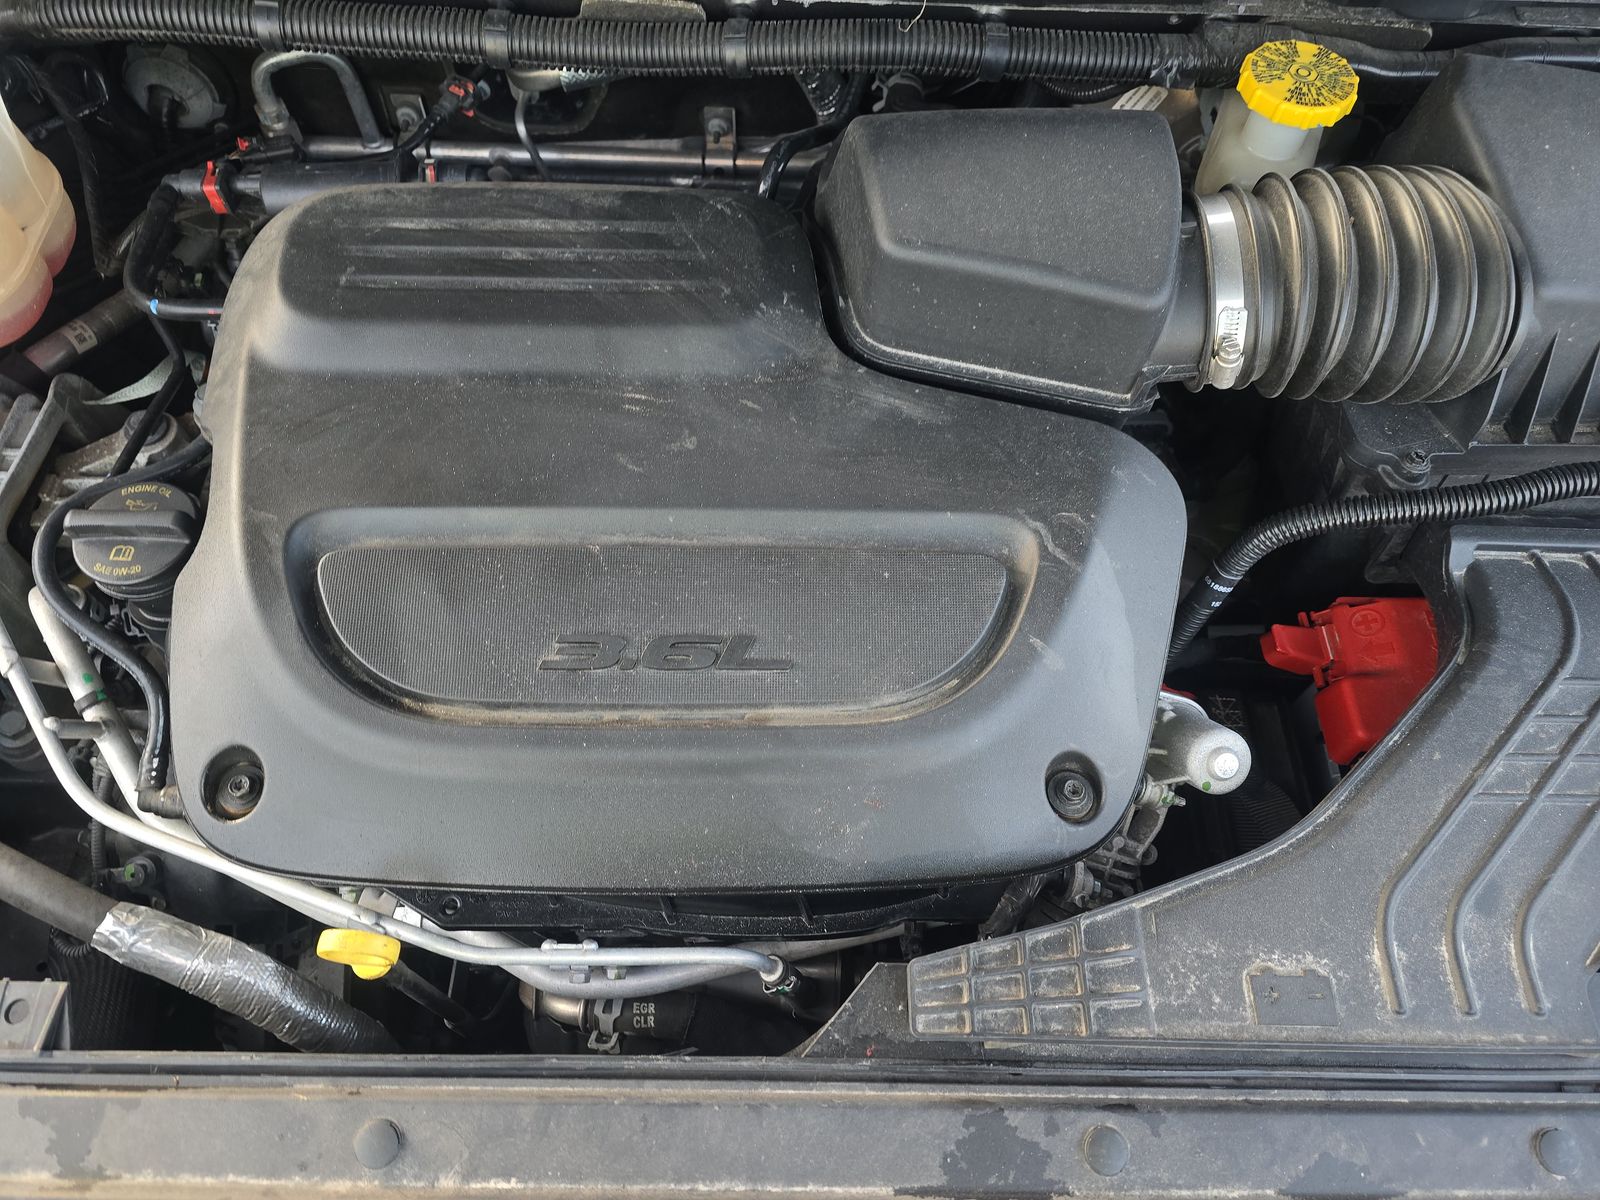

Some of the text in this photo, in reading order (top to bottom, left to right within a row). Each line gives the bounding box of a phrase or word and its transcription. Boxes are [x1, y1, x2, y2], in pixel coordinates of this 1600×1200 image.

[121, 484, 173, 499] ENGINE OIL
[93, 562, 142, 576] SAE 0W-20
[537, 633, 793, 671] 3.6L
[632, 1002, 656, 1014] EGR
[633, 1015, 656, 1029] CLR
